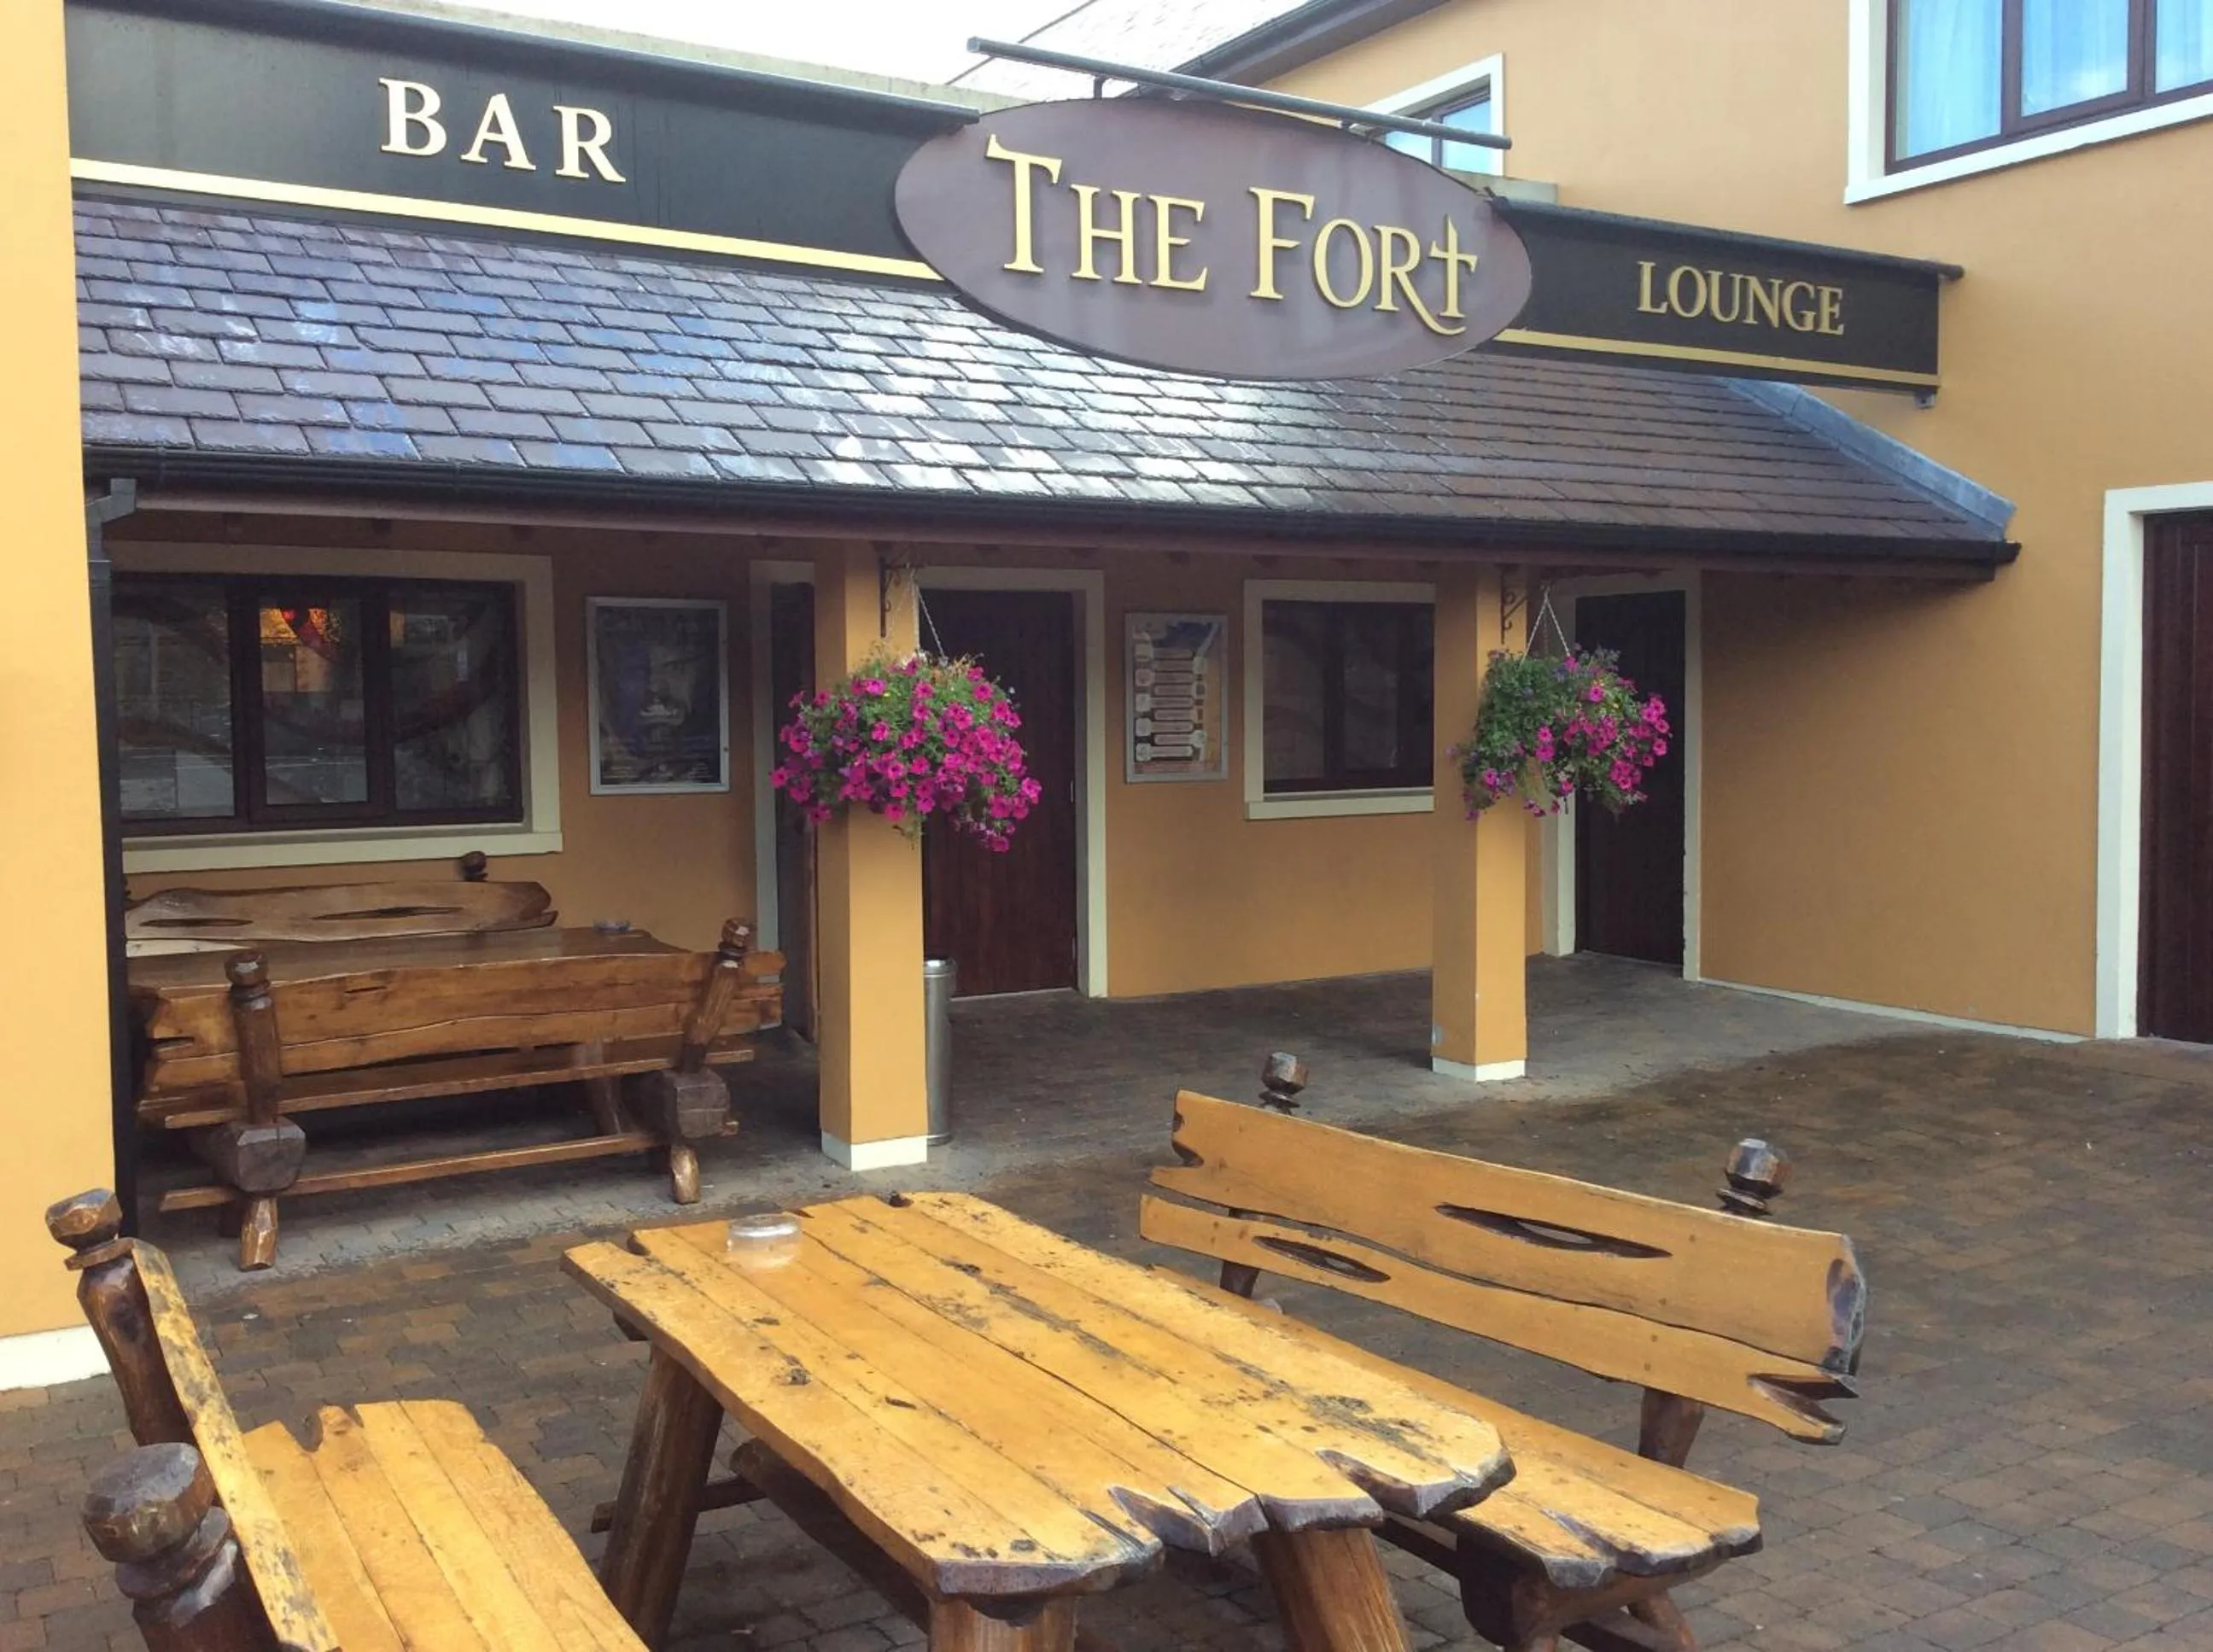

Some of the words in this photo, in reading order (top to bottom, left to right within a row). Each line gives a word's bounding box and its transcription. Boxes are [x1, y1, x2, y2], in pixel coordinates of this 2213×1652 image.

[378, 77, 627, 183] BAR
[984, 132, 1209, 291] THE
[1636, 260, 1844, 336] LOUNGE
